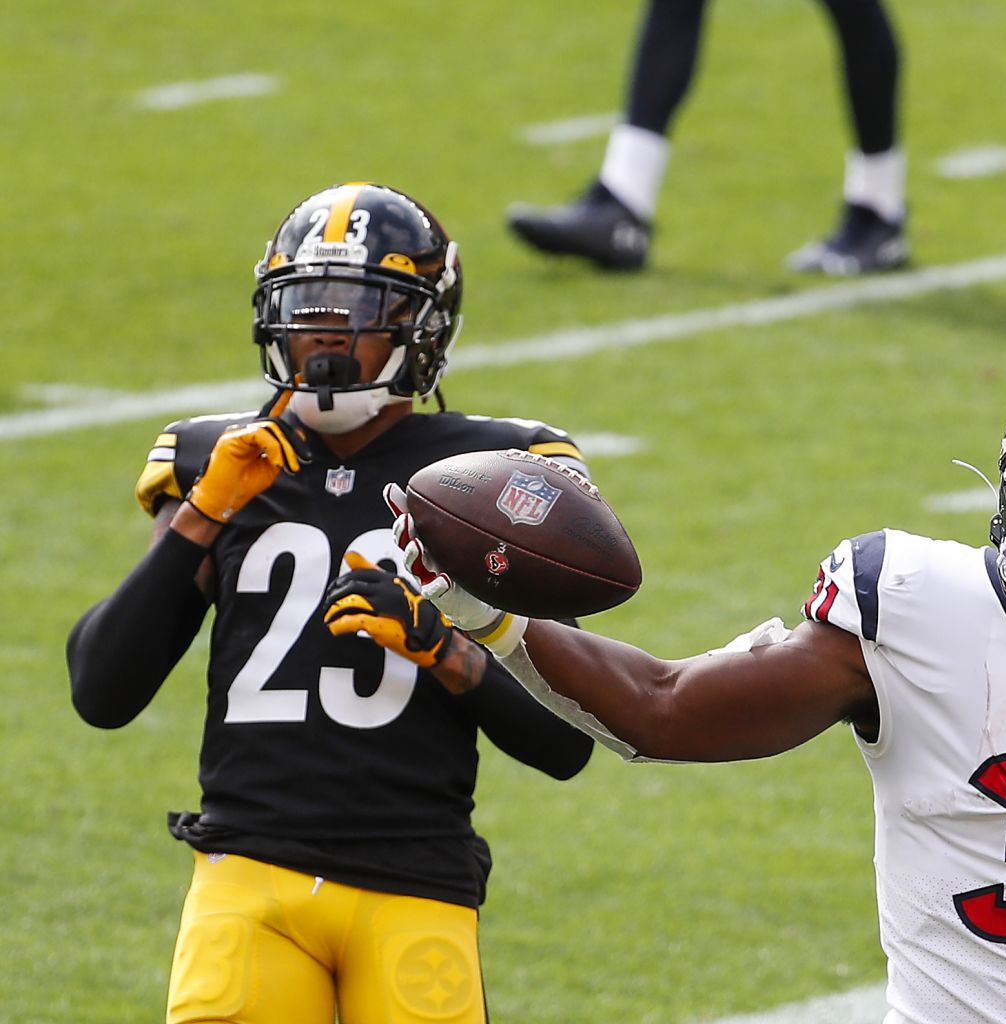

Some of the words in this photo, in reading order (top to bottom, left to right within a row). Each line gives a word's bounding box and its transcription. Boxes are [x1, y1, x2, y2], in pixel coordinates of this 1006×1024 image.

[303, 208, 371, 245] 23
[439, 475, 475, 494] Wilson
[503, 487, 543, 519] NFL
